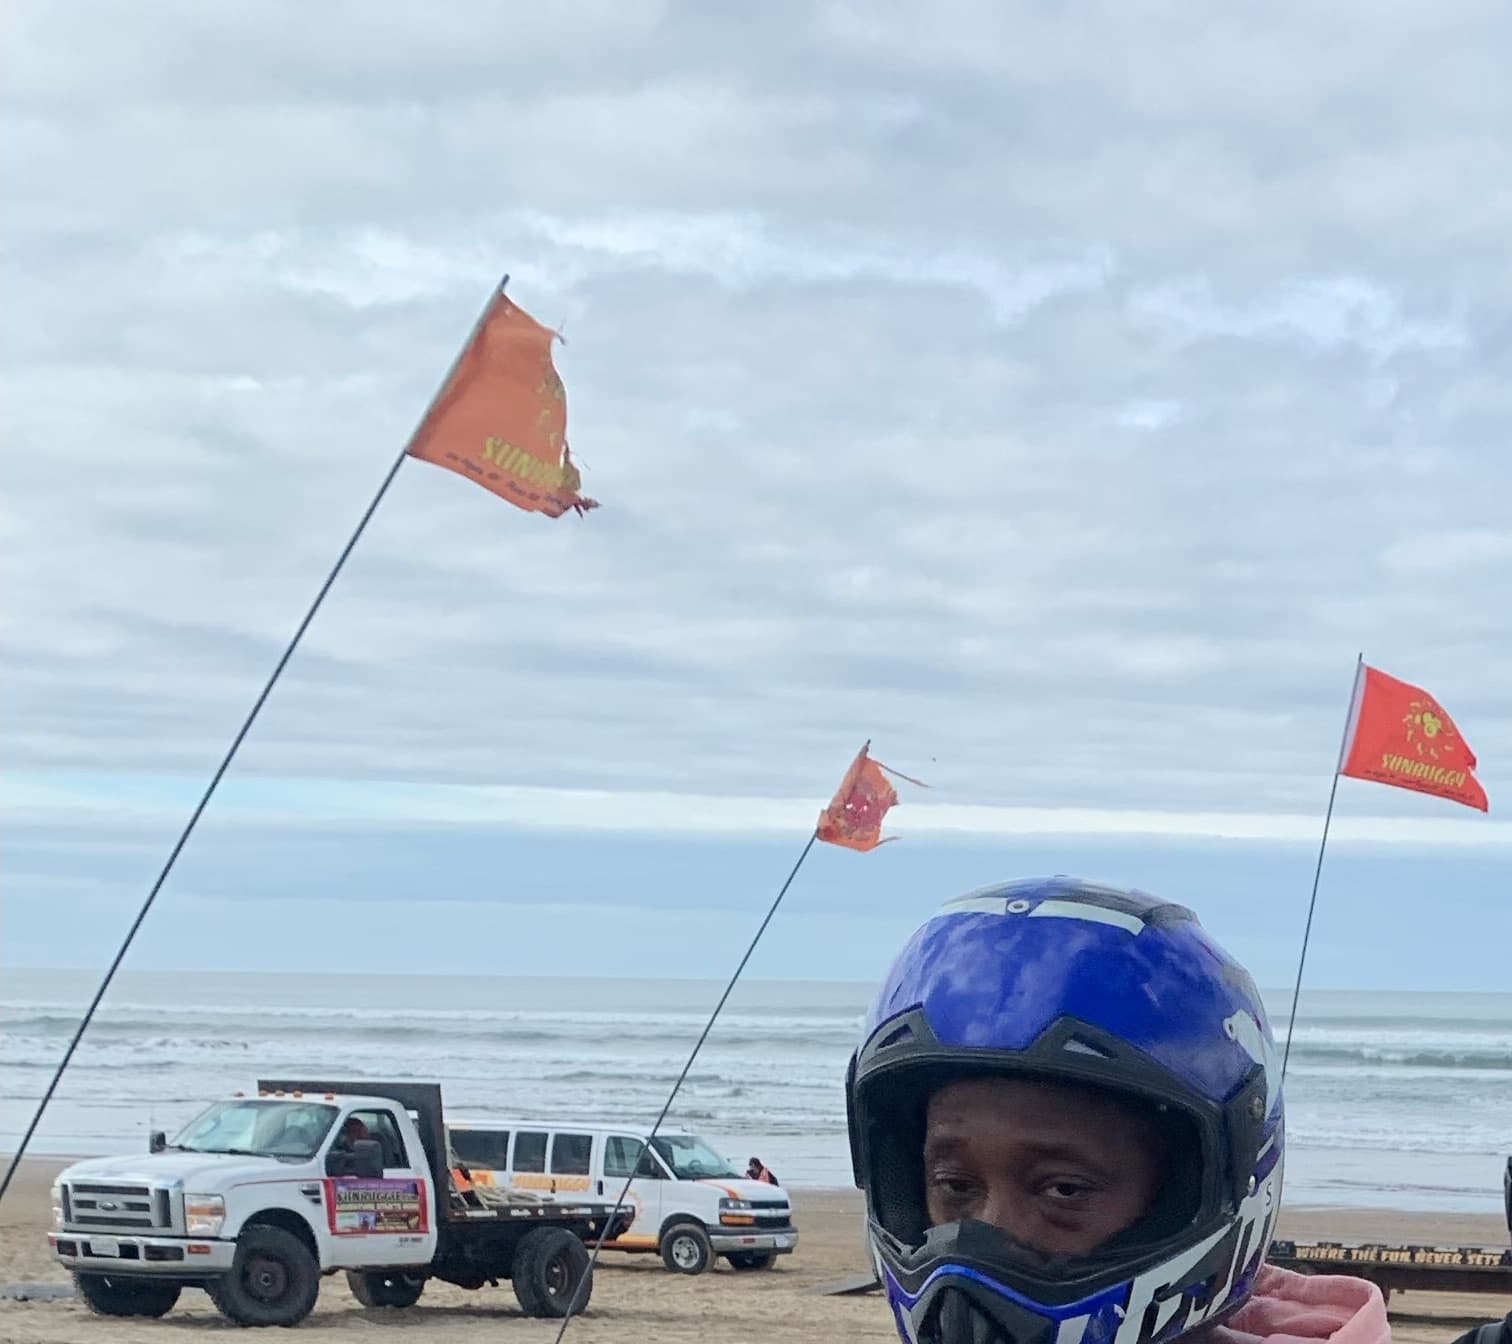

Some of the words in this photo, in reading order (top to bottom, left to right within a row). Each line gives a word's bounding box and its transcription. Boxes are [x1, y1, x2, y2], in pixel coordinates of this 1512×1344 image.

[1381, 753, 1467, 788] SUNBUGGY
[1296, 1247, 1346, 1260] WHERE
[1351, 1249, 1378, 1261] THE
[1381, 1250, 1411, 1263] FUN
[1467, 1253, 1502, 1266] SETS
